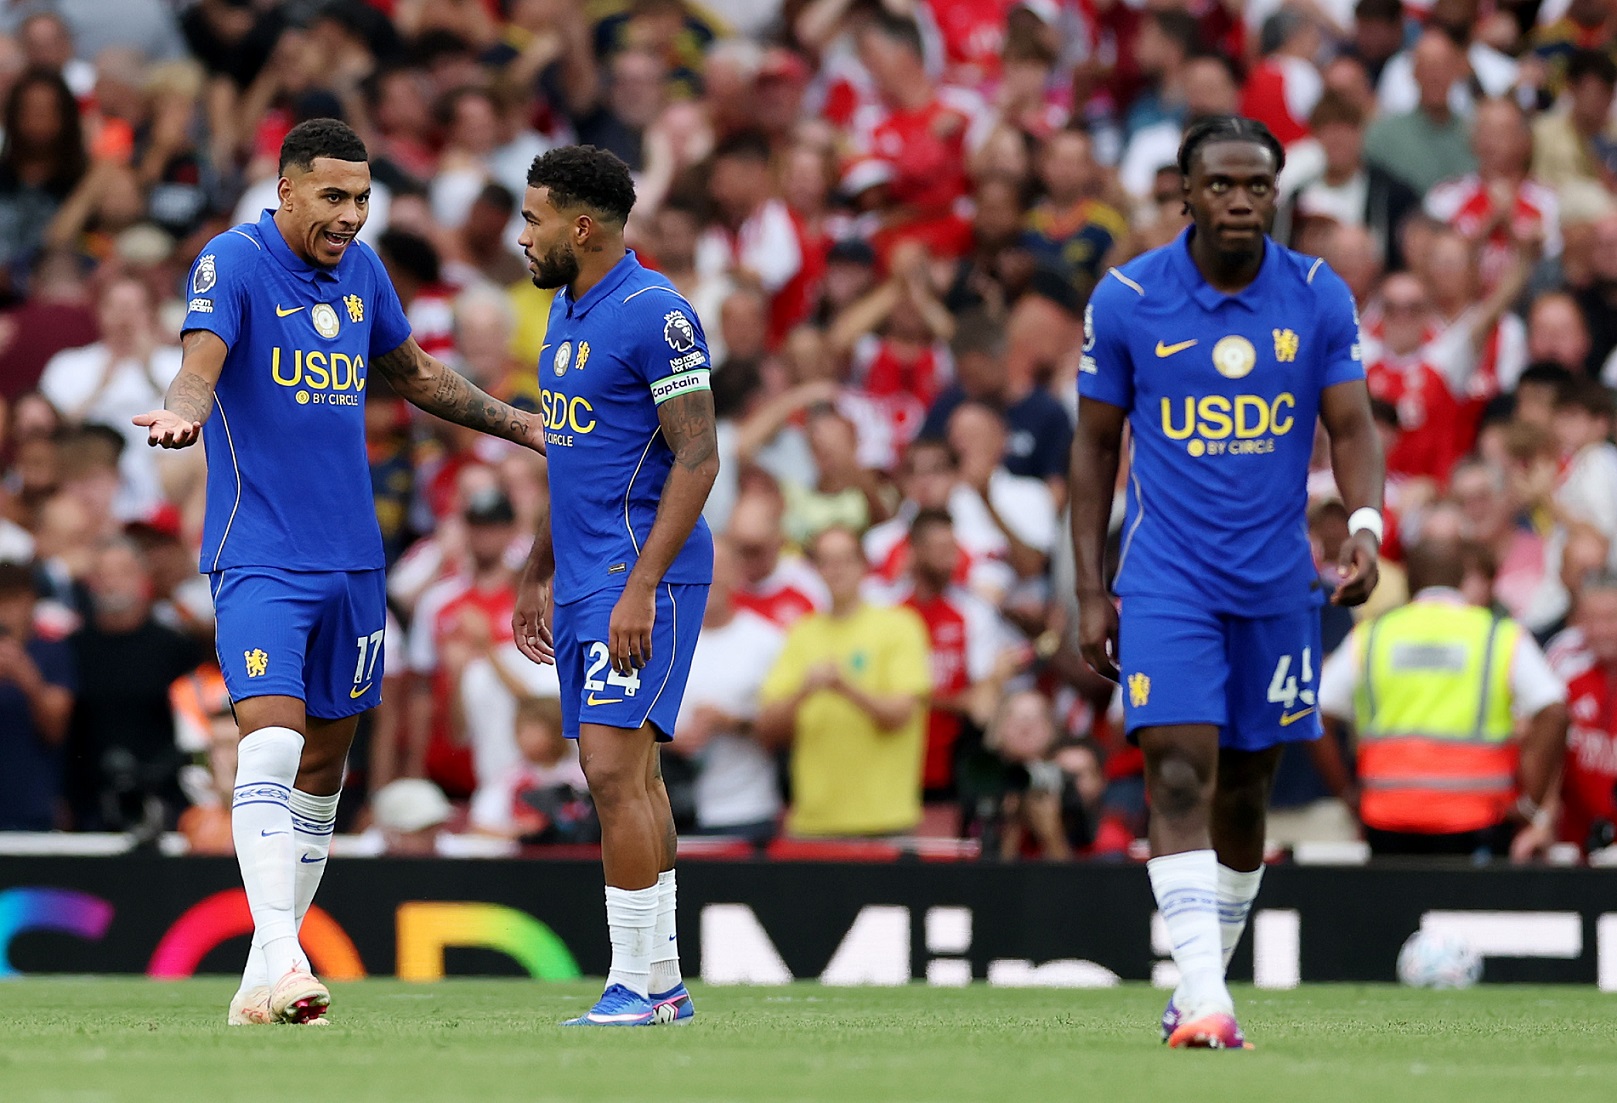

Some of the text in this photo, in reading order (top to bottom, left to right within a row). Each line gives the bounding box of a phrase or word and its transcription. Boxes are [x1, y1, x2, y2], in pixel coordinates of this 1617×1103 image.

[669, 350, 701, 367] No room
[671, 356, 706, 373] for racism
[271, 347, 366, 392] USDC
[652, 375, 699, 397] Captain
[313, 393, 358, 406] BY CIRCLE
[1160, 392, 1296, 440] USDC
[547, 433, 574, 447] CIRCLE
[1207, 438, 1274, 455] BY CIRCE
[353, 629, 384, 684] 17
[584, 641, 641, 697] 24
